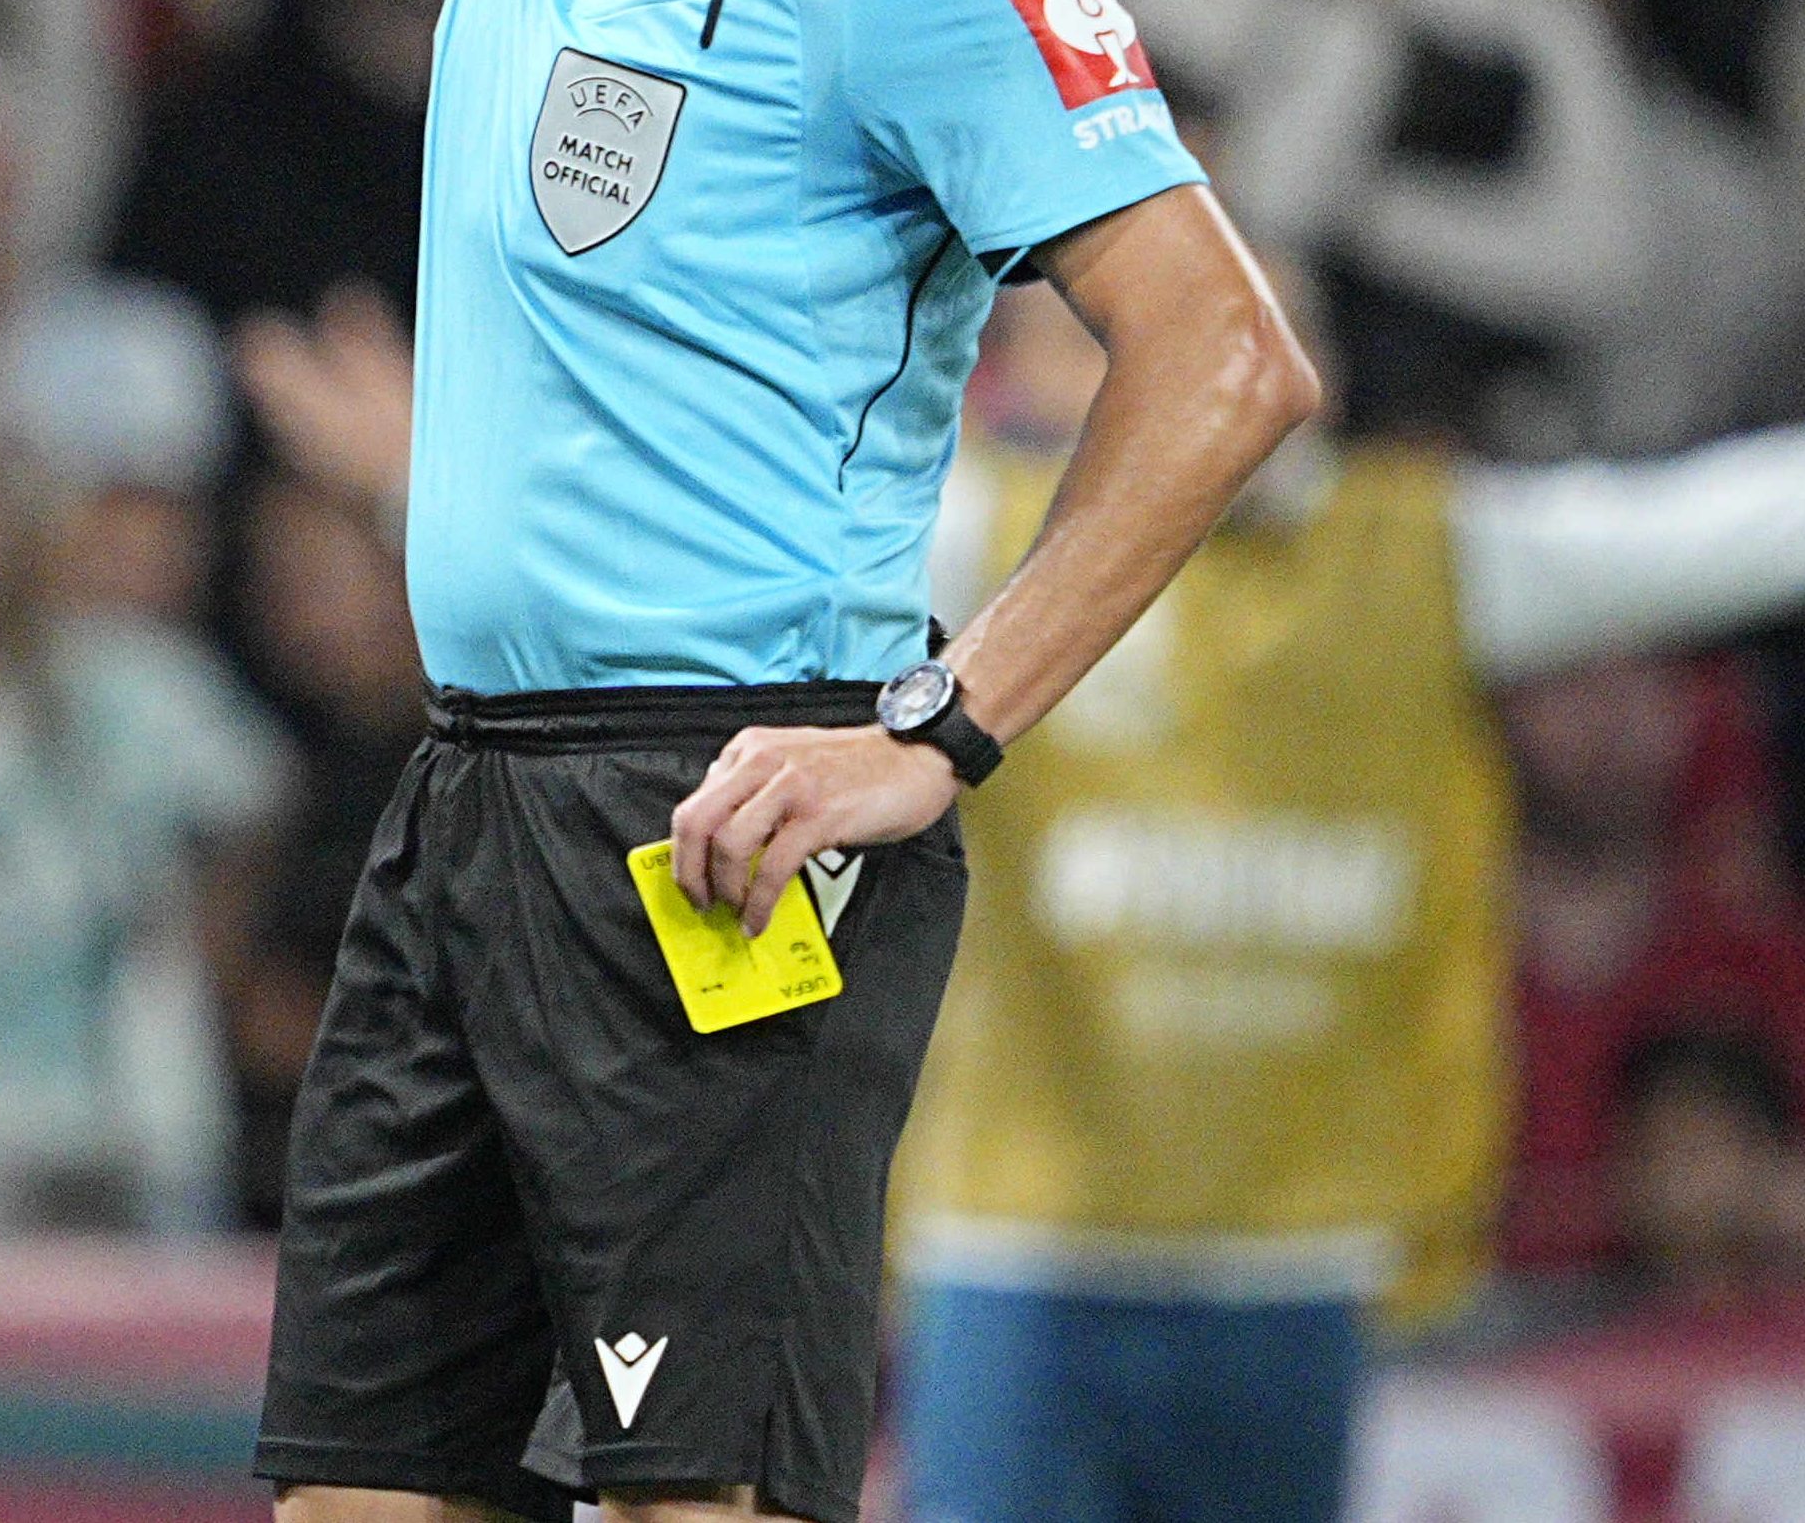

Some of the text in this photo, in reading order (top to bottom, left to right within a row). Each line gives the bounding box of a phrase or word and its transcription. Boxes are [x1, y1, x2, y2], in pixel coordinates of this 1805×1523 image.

[570, 84, 646, 129] UEFA
[559, 135, 633, 173] MATCH
[543, 161, 630, 205] OFFICIAL
[779, 975, 828, 998] UEFA
